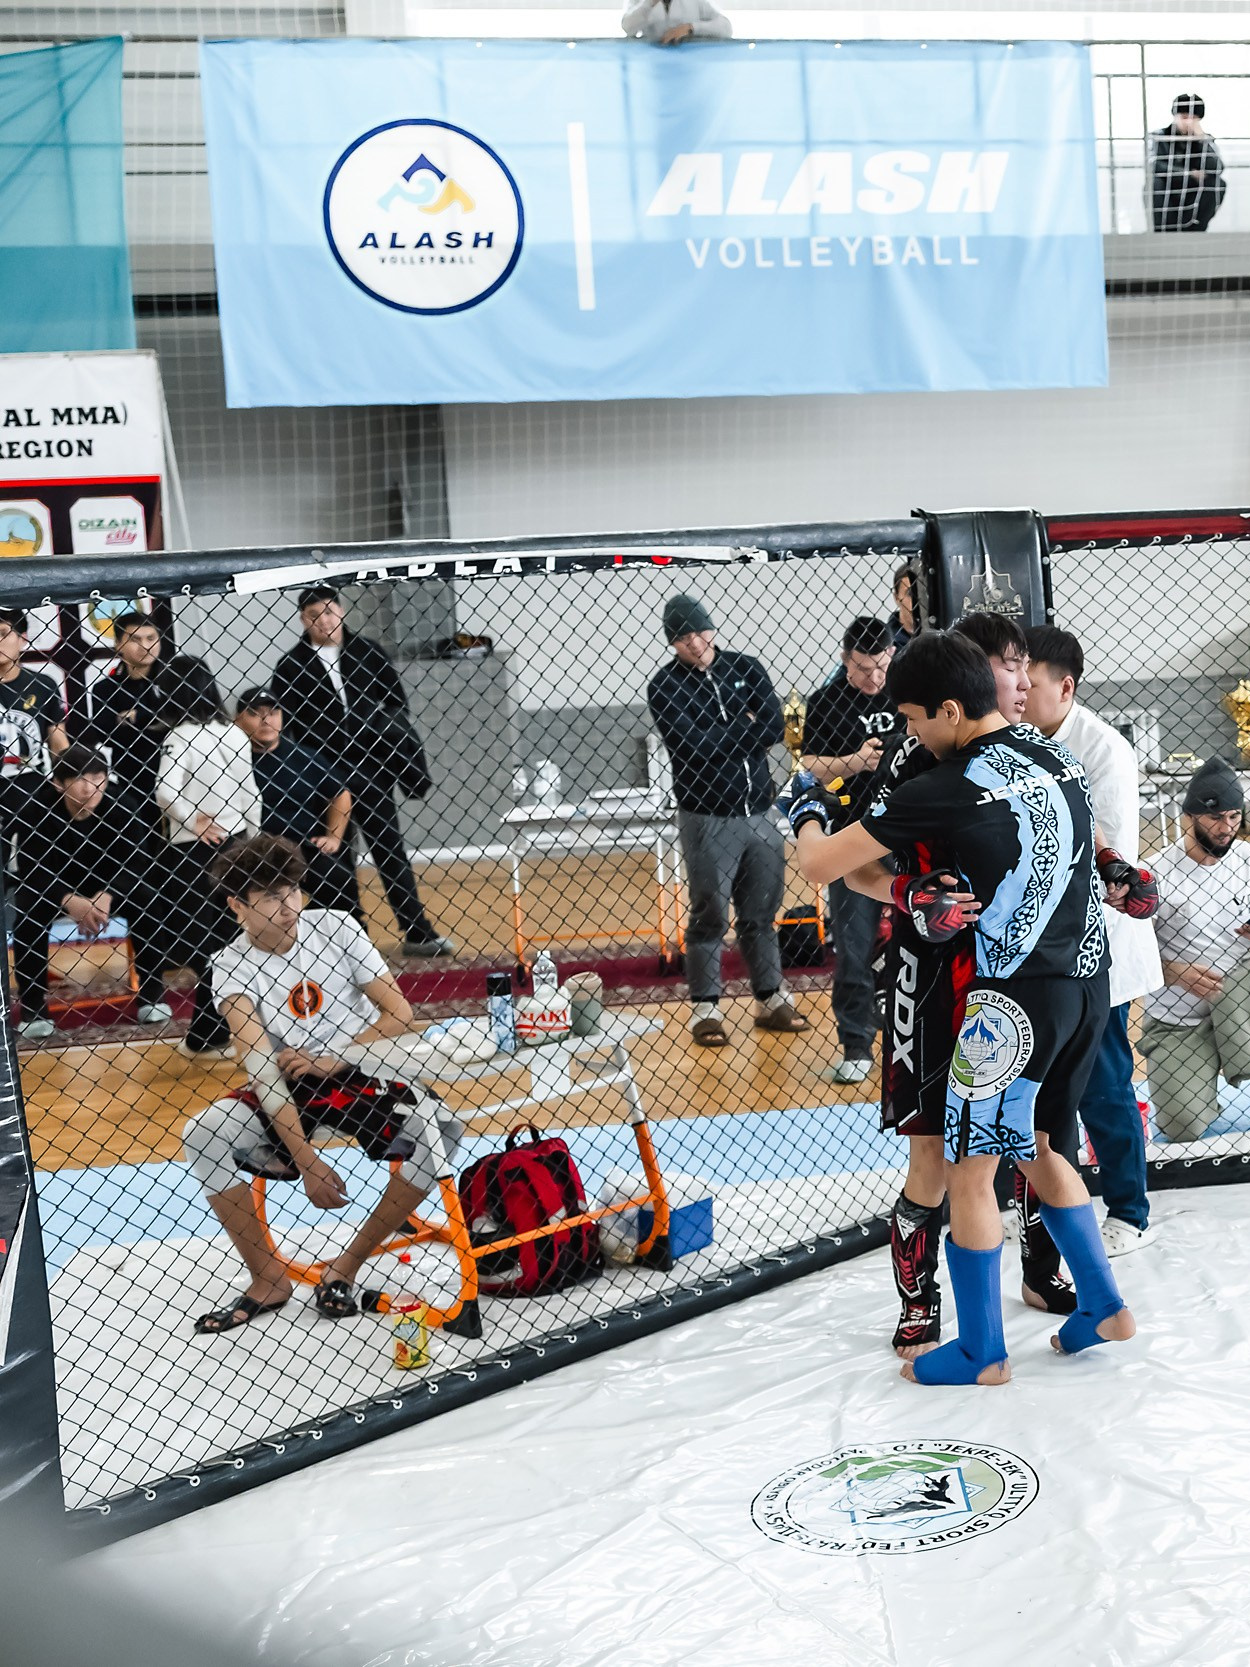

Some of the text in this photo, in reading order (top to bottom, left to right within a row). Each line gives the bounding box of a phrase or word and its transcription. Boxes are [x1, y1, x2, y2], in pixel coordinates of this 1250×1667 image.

[645, 150, 1010, 216] ALASH
[359, 231, 494, 249] ALASH
[685, 235, 980, 269] VOLLEYBALL
[379, 255, 475, 265] VOLLEYBALL
[52, 402, 127, 426] MMA)
[78, 517, 137, 531] DIZAIN
[890, 735, 921, 778] RD
[892, 946, 919, 1074] RDX
[990, 994, 1023, 1019] SPORT
[916, 1519, 990, 1546] SPORT
